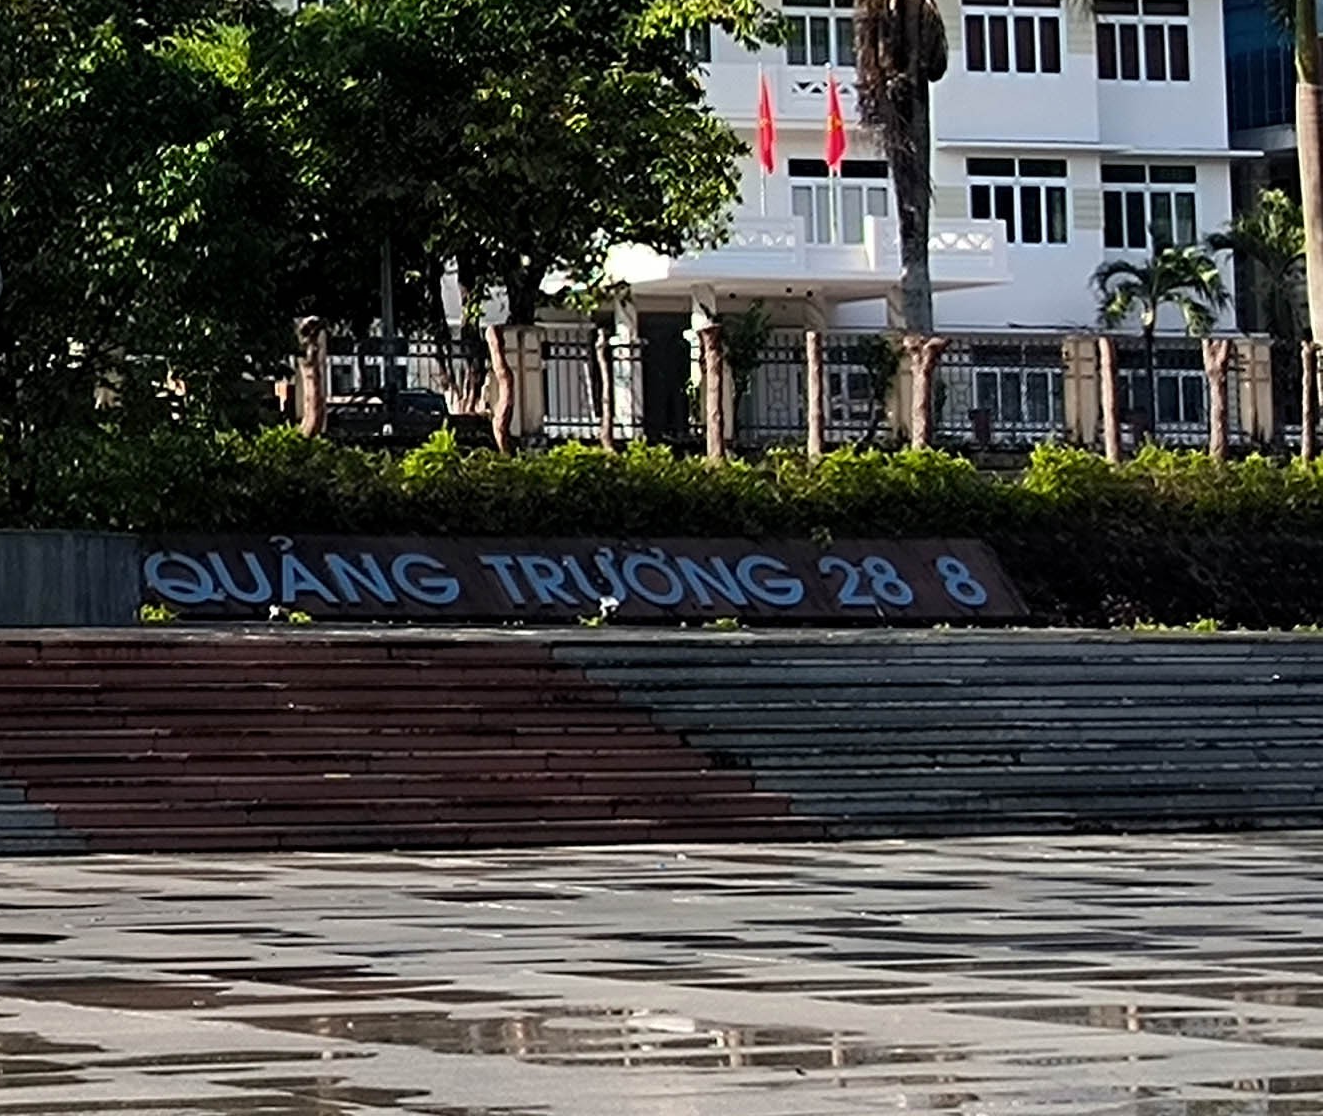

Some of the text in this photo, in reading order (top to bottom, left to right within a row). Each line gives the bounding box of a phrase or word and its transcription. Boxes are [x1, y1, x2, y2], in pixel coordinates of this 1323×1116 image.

[142, 535, 460, 604] QUẢNG
[818, 555, 914, 607] 28
[936, 555, 987, 606] 8
